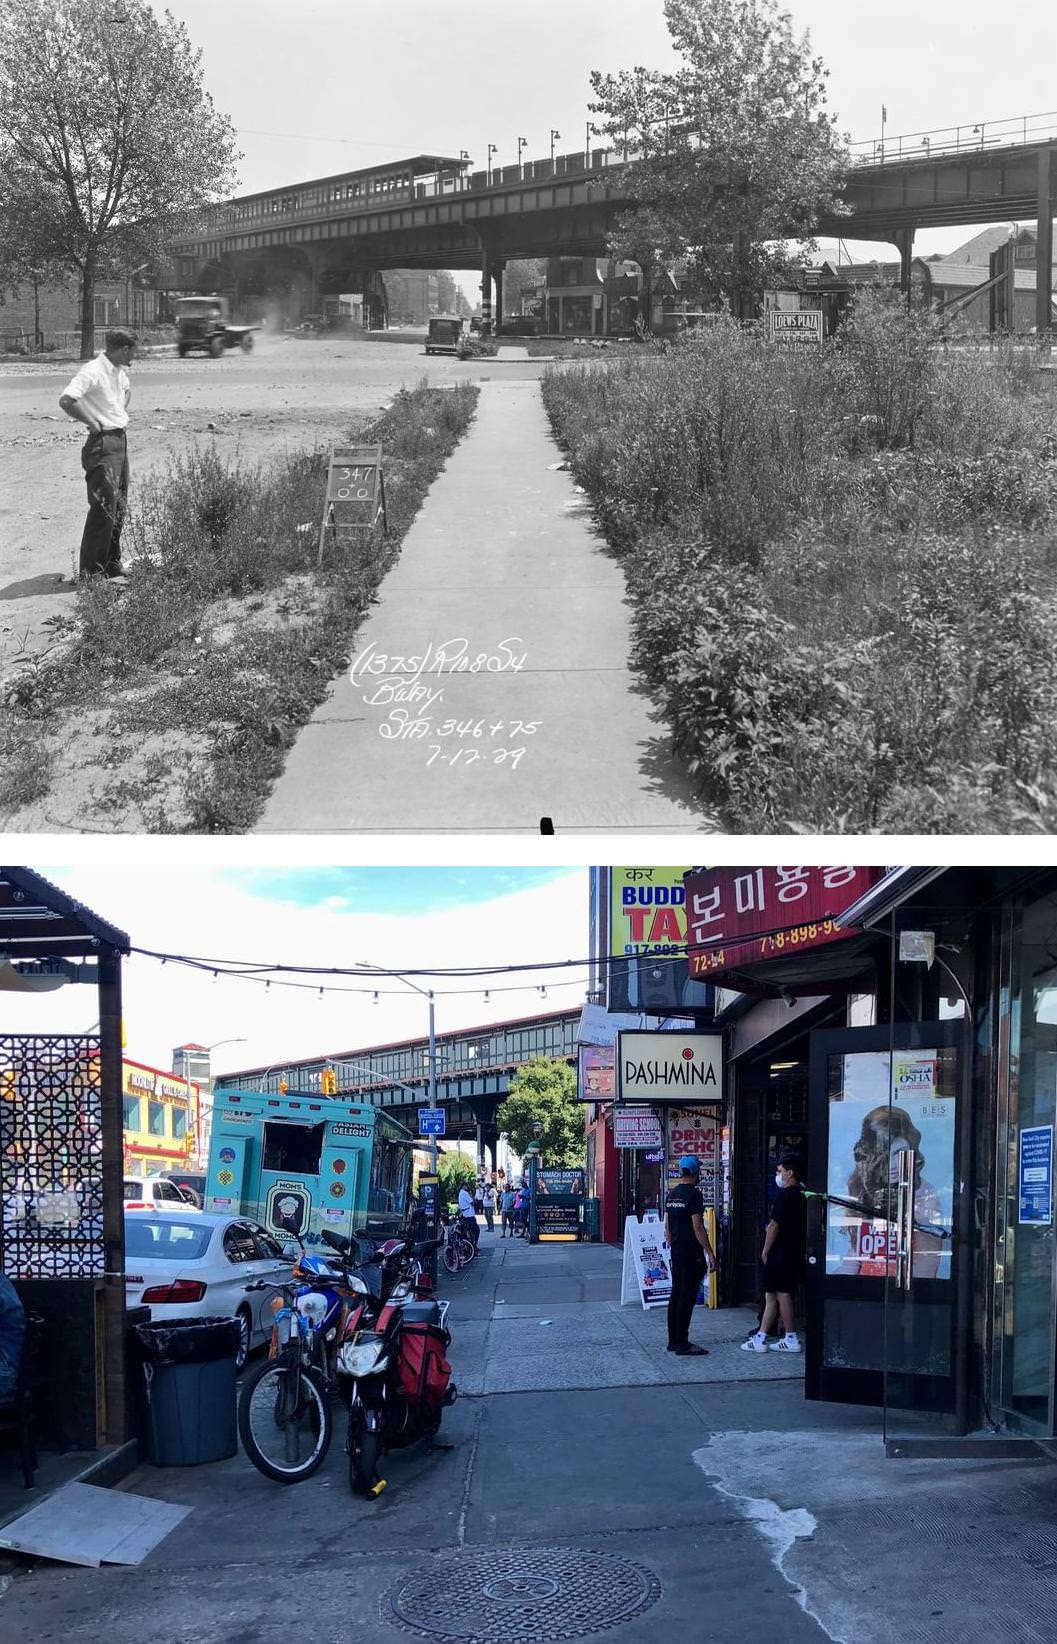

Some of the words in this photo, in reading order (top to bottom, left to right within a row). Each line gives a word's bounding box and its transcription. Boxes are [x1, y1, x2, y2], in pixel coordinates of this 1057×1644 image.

[338, 467, 373, 481] 347
[624, 868, 656, 882] कर
[622, 907, 688, 943] TA
[625, 1060, 717, 1086] PASHMINA
[332, 1127, 371, 1137] DELIGHT
[861, 1234, 907, 1255] OPE
